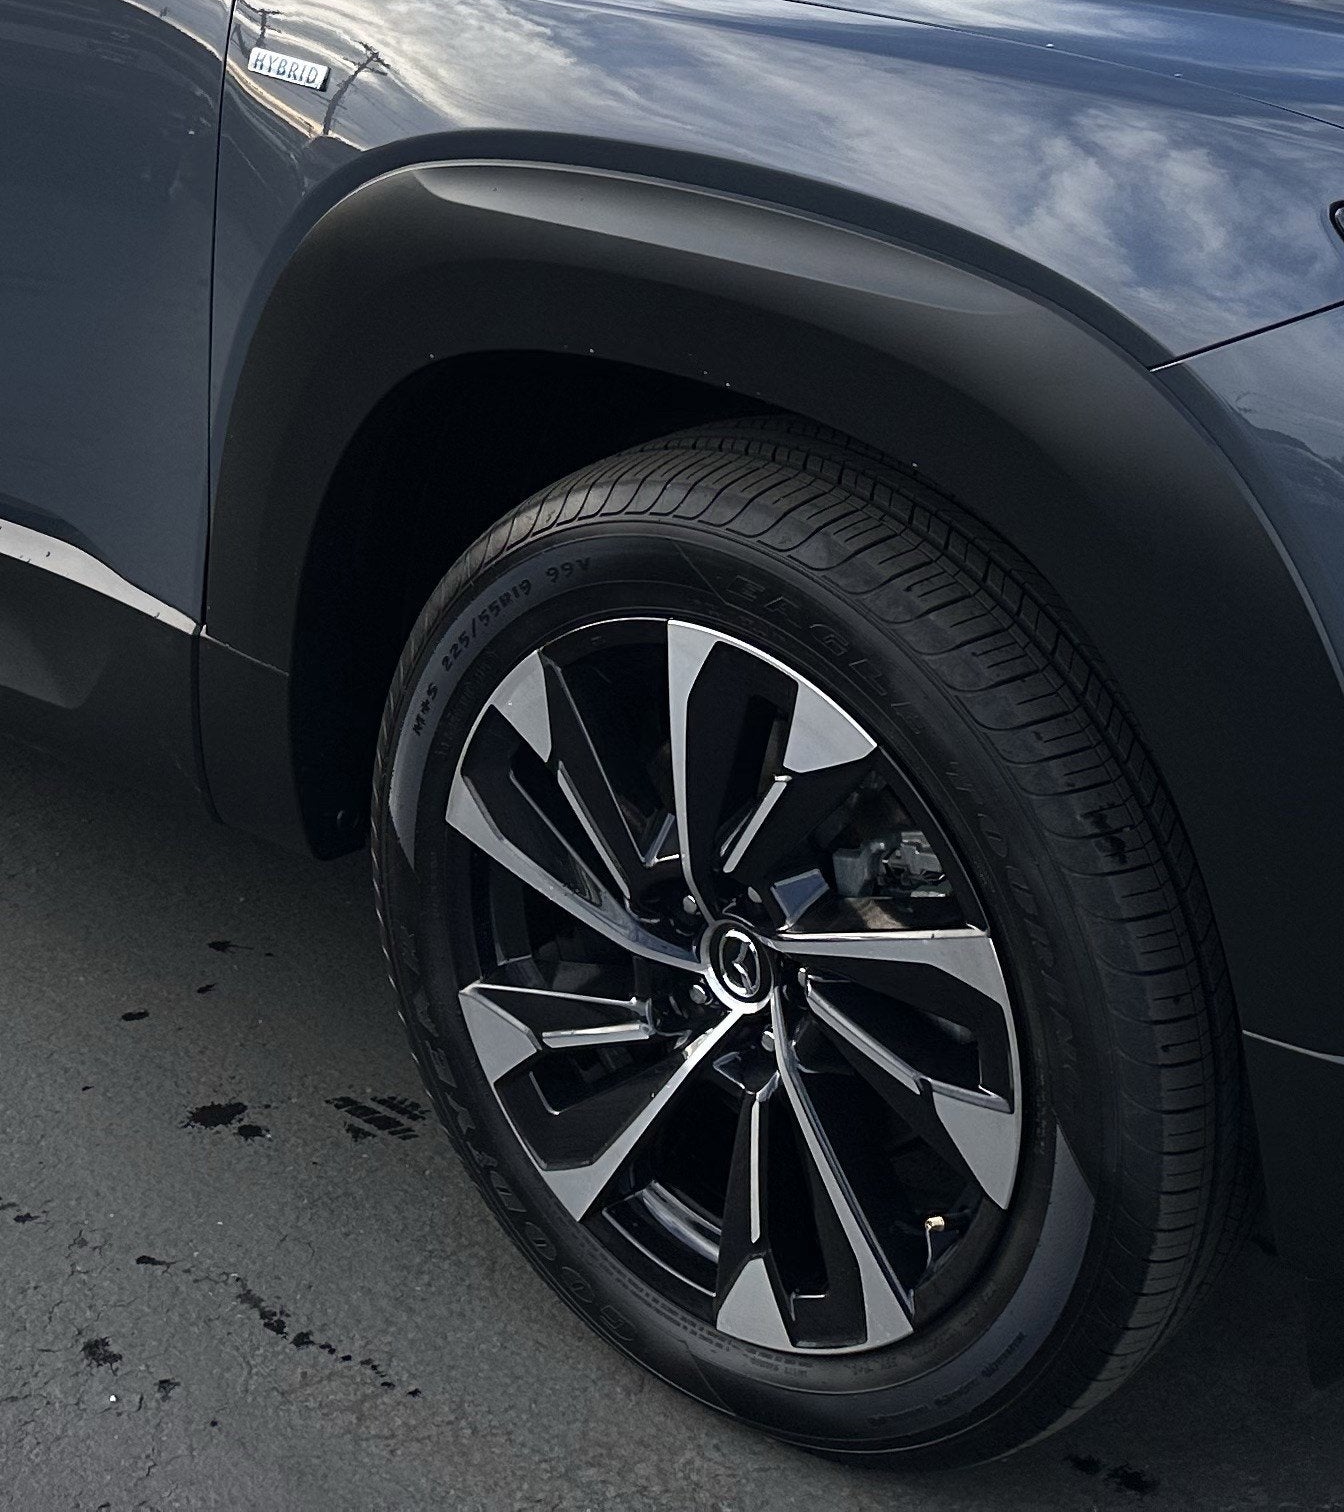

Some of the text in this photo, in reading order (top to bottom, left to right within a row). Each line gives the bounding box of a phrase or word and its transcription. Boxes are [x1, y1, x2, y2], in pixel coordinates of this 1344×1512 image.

[253, 52, 319, 84] HYBRID
[441, 578, 532, 672] 225/55R19
[545, 556, 592, 584] 99V
[726, 572, 926, 737] EAGLE
